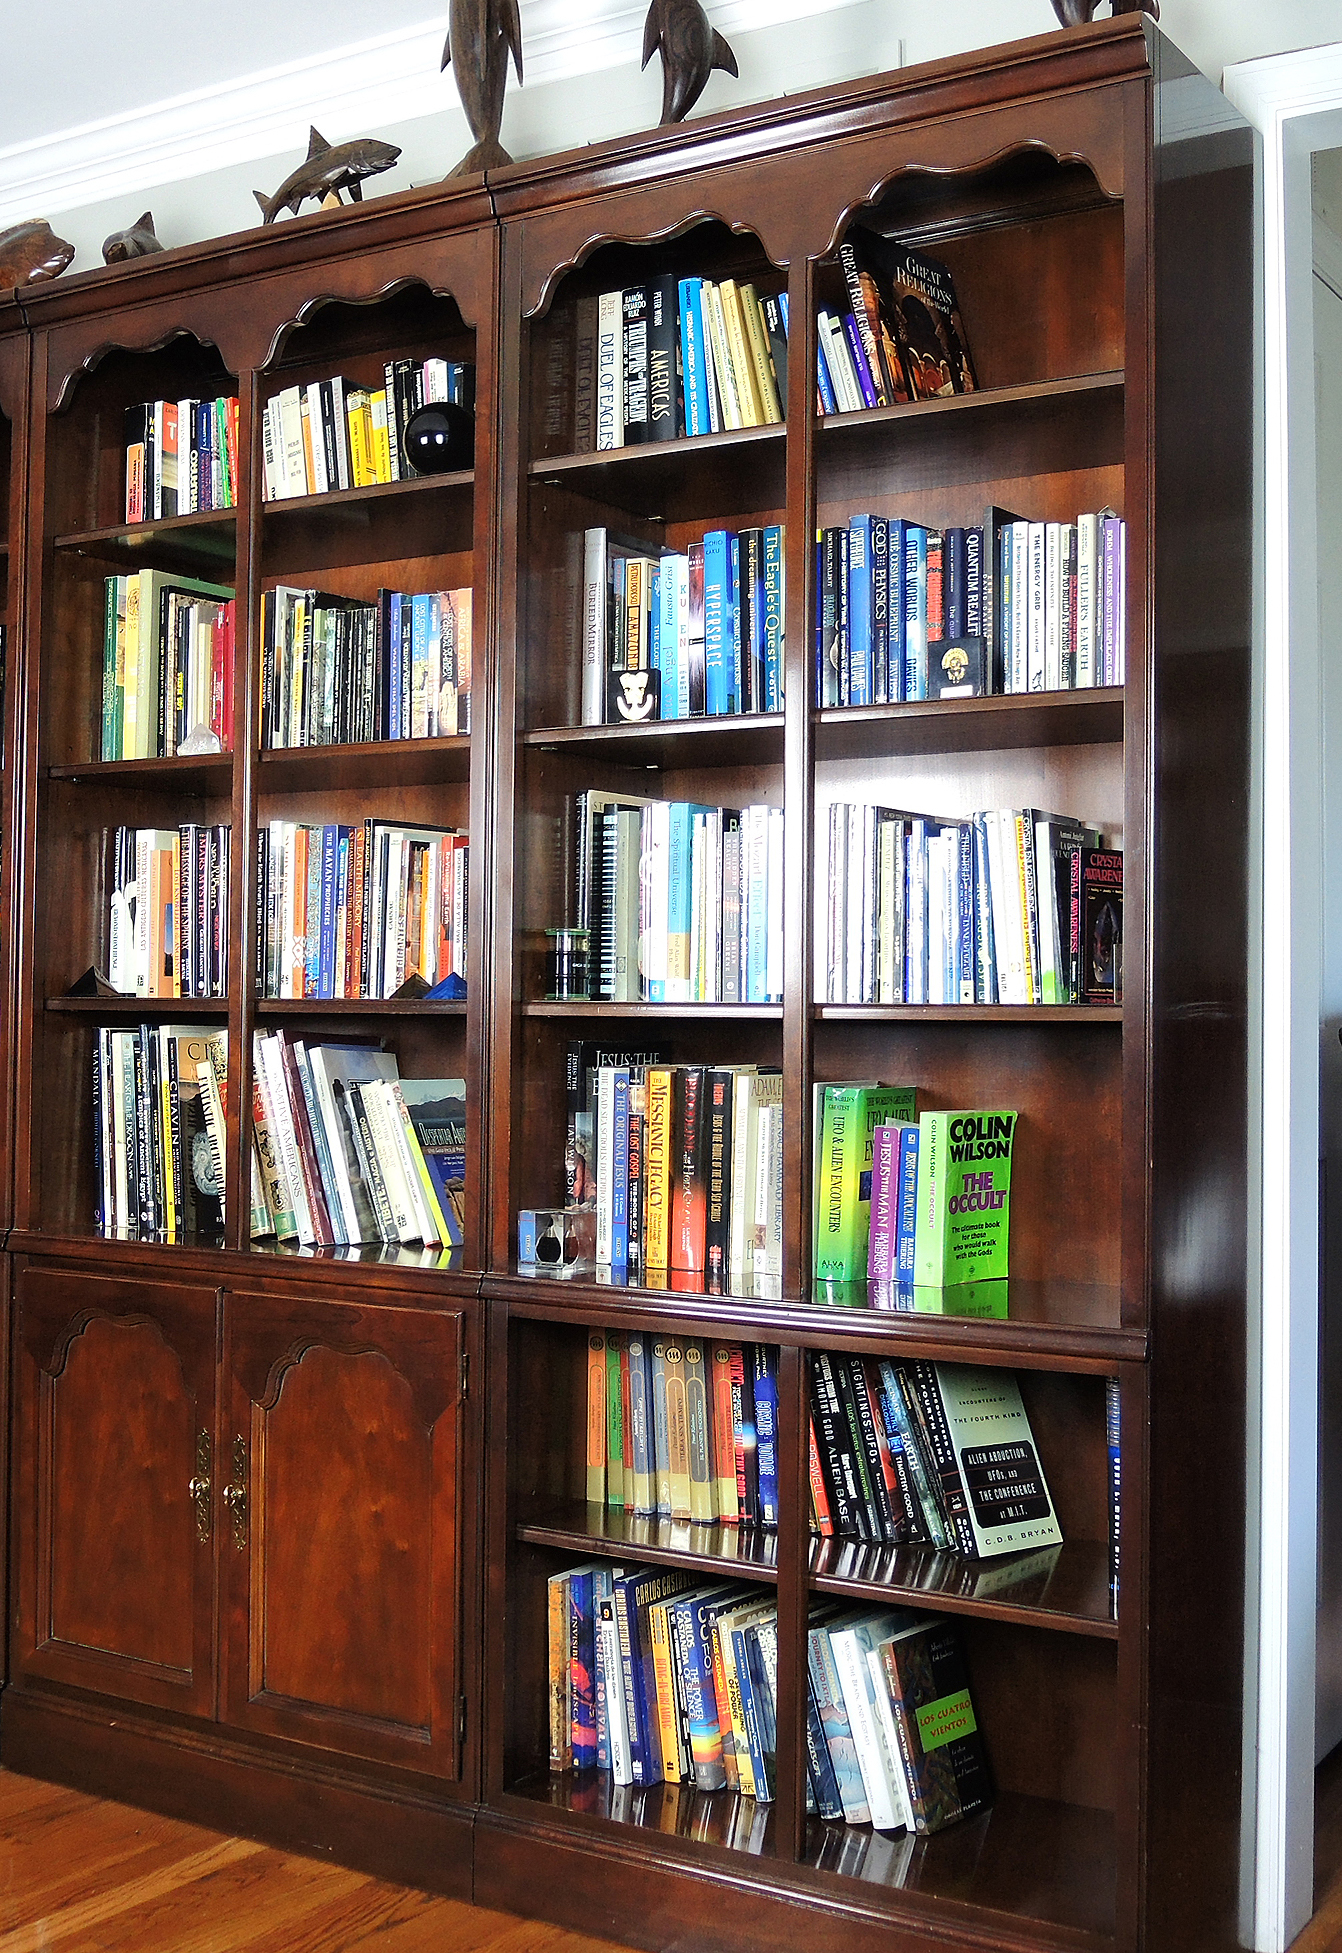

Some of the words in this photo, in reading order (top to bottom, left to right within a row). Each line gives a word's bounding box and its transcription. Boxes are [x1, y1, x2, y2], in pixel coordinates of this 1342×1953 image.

[896, 266, 953, 306] RELIGIONS
[906, 256, 942, 285] GREAT
[839, 244, 859, 284] GREAT
[850, 286, 874, 356] RELIGIONS
[600, 333, 614, 371] DUEL
[628, 322, 647, 372] TRIUMPHS
[600, 374, 614, 391] OF
[650, 350, 670, 421] AMERICAS
[628, 379, 647, 424] TRAGEDY
[600, 395, 614, 451] EAGLES
[766, 533, 778, 559] The
[876, 524, 886, 554] GOD
[630, 565, 638, 581] PETRU
[906, 540, 917, 575] OTHER
[630, 582, 638, 605] POPESCU
[748, 557, 756, 598] dreaming
[764, 561, 779, 612] Eagle's
[1062, 578, 1068, 587] TO
[1080, 564, 1088, 621] FULLER'S
[588, 582, 597, 622] BURIED
[876, 569, 886, 620] PHYSICS
[906, 577, 917, 621] WORLDS
[706, 584, 722, 668] HYPERSPACE
[764, 615, 780, 662] Quest
[587, 624, 596, 665] MIRROR
[1081, 626, 1089, 670] EARTH
[906, 658, 917, 693] DAVIES
[181, 831, 189, 850] THE
[673, 819, 681, 836] The
[181, 850, 189, 887] MESSAGE
[325, 848, 334, 881] MAYAN
[355, 846, 363, 881] EARTH
[671, 838, 681, 874] Spiritual
[1071, 852, 1079, 894] CRYSTAL
[181, 888, 188, 898] OF
[600, 1072, 609, 1084] THE
[713, 1083, 724, 1105] THIERING
[170, 1080, 180, 1145] CHAVIN
[198, 1076, 213, 1128] FANTASTIC
[600, 1088, 609, 1109] DEAD
[617, 1095, 626, 1112] THE
[600, 1111, 608, 1126] SEA
[630, 1117, 639, 1130] THE
[650, 1084, 668, 1157] MESSIANIC
[833, 1116, 844, 1135] UFO
[949, 1116, 1013, 1144] COLIN
[274, 1082, 290, 1127] NATIVE
[282, 1129, 302, 1197] AMERICANS
[600, 1128, 608, 1160] SCROLLS
[616, 1115, 626, 1160] ORIGINAL
[630, 1133, 639, 1150] LOST
[950, 1140, 1010, 1164] WILSON
[566, 1149, 574, 1195] WILSON
[630, 1153, 639, 1179] GOSPEL
[831, 1145, 843, 1172] ALIEN
[600, 1163, 608, 1204] DECEPTION
[616, 1163, 625, 1188] JESUS
[650, 1159, 665, 1210] LEGACY
[962, 1172, 993, 1192] THE
[829, 1175, 842, 1233] ENCOUNTERS
[948, 1190, 1006, 1215] OCCULT
[880, 1233, 889, 1272] BARBARA
[956, 1252, 968, 1260] with
[968, 1250, 977, 1258] the
[965, 1241, 982, 1249] would
[982, 1238, 996, 1247] walk
[820, 1354, 832, 1379] VISITORS
[825, 1380, 836, 1397] FROM
[757, 1401, 773, 1435] COSMIC
[816, 1379, 830, 1414] TIMOTHY
[823, 1419, 834, 1440] GOOD
[829, 1398, 839, 1413] TIME
[970, 1414, 1000, 1422] FOURTH
[736, 1434, 745, 1471] TIMOTHY
[758, 1442, 774, 1476] VOYAGE
[902, 1432, 919, 1471] EARTH
[968, 1452, 987, 1465] ALIEN
[989, 1448, 1028, 1463] ABDUCTION,
[738, 1474, 746, 1497] GOOD
[810, 1445, 822, 1497] ROSWELL
[828, 1446, 842, 1485] ALIEN
[835, 1489, 849, 1524] BASE
[894, 1456, 908, 1492] TIMOTHY
[903, 1494, 914, 1519] GOOD
[979, 1489, 992, 1502] THE
[994, 1483, 1037, 1499] CONFERENCE
[984, 1534, 1017, 1546] C.D.B.
[1021, 1527, 1054, 1538] BRYAN
[615, 1589, 629, 1615] CARLOS
[617, 1616, 631, 1656] CASTANEDA
[676, 1611, 688, 1665] CASTANEDA
[683, 1610, 695, 1648] CARLOS
[711, 1628, 719, 1654] CARLOS
[721, 1621, 731, 1664] CASTANEDA
[622, 1660, 632, 1675] THE
[624, 1676, 633, 1689] ART
[684, 1668, 691, 1680] OF
[690, 1666, 699, 1686] THE
[714, 1656, 724, 1692] CASTANEDA
[728, 1679, 735, 1688] OF
[626, 1690, 634, 1700] OF
[685, 1681, 696, 1718] SILENCE
[693, 1688, 704, 1720] POWER
[730, 1690, 739, 1719] POWER
[626, 1701, 637, 1742] DREAMING
[893, 1704, 903, 1721] LOS
[920, 1714, 936, 1727] LOS
[938, 1699, 971, 1720] CUATRO
[929, 1717, 967, 1738] VIENTOS
[896, 1723, 912, 1760] CUATRO
[903, 1761, 920, 1801] VIENTOS
